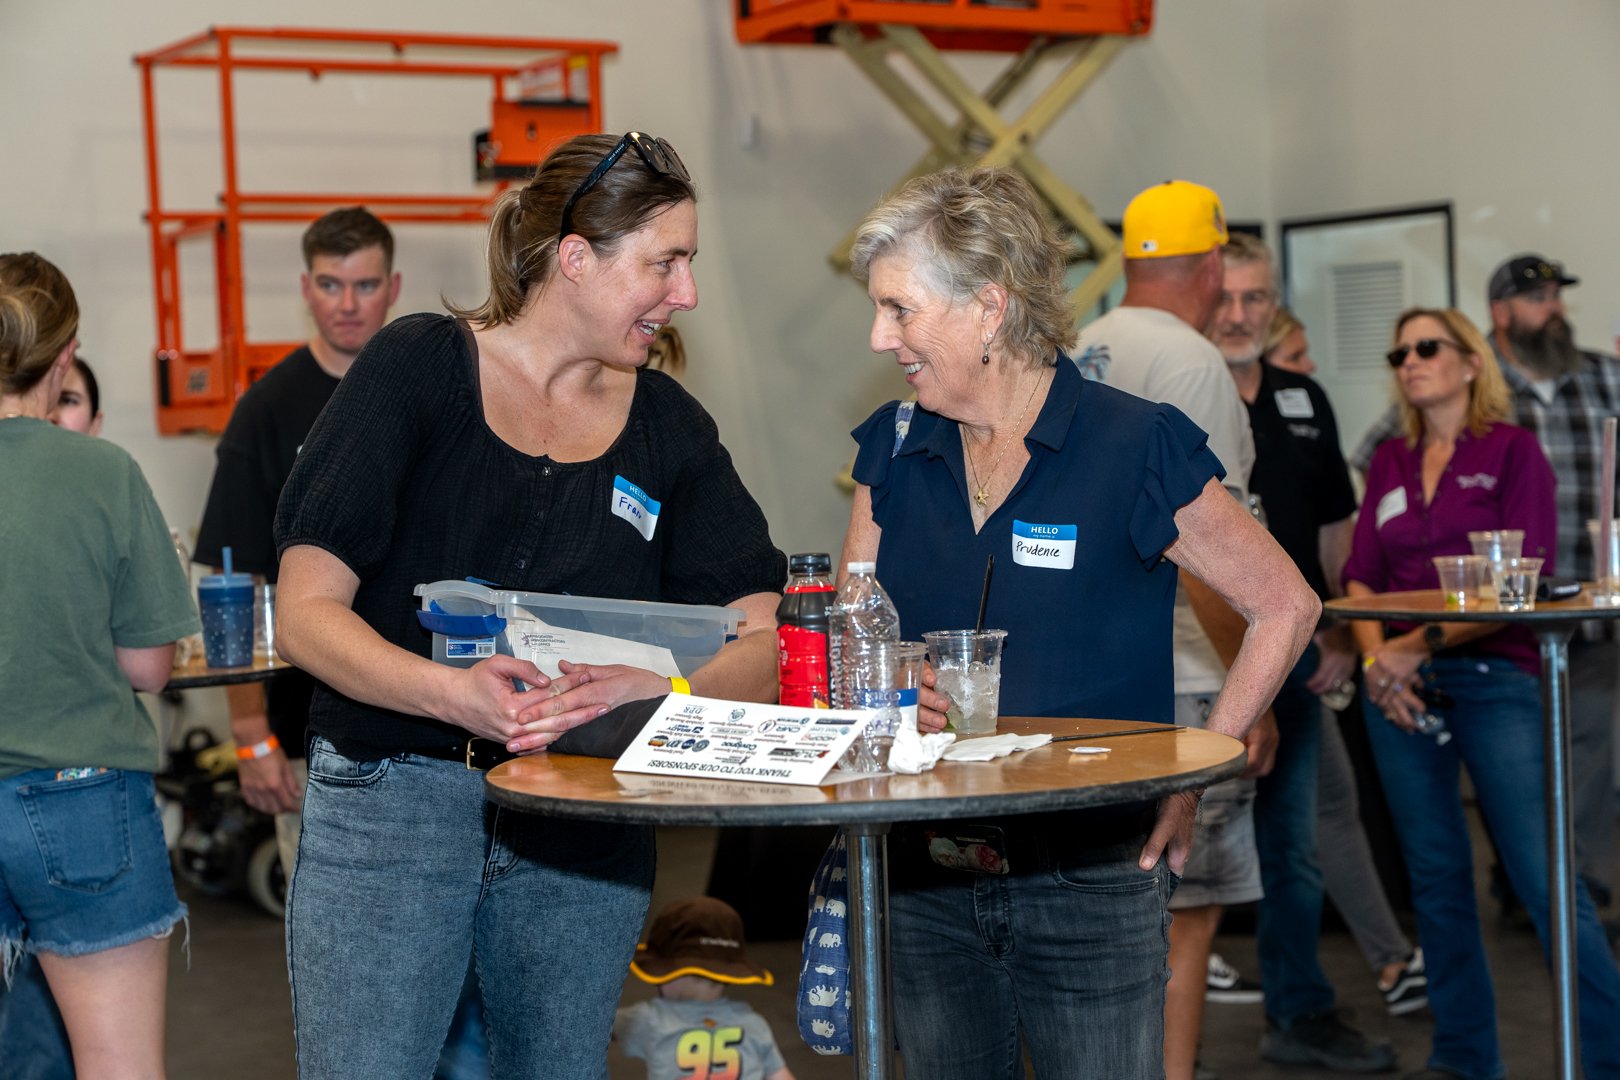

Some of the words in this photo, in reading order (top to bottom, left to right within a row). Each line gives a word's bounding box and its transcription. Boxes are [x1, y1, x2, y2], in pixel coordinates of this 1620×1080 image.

[629, 485, 647, 502] HELLO
[1030, 526, 1059, 534] HELLO
[1016, 540, 1060, 557] Prudence
[647, 760, 699, 770] SPONSORS!
[698, 763, 720, 773] OUR
[720, 765, 734, 774] TO
[734, 766, 755, 775] YOU
[754, 768, 791, 777] THANK
[675, 1026, 744, 1080] 95
